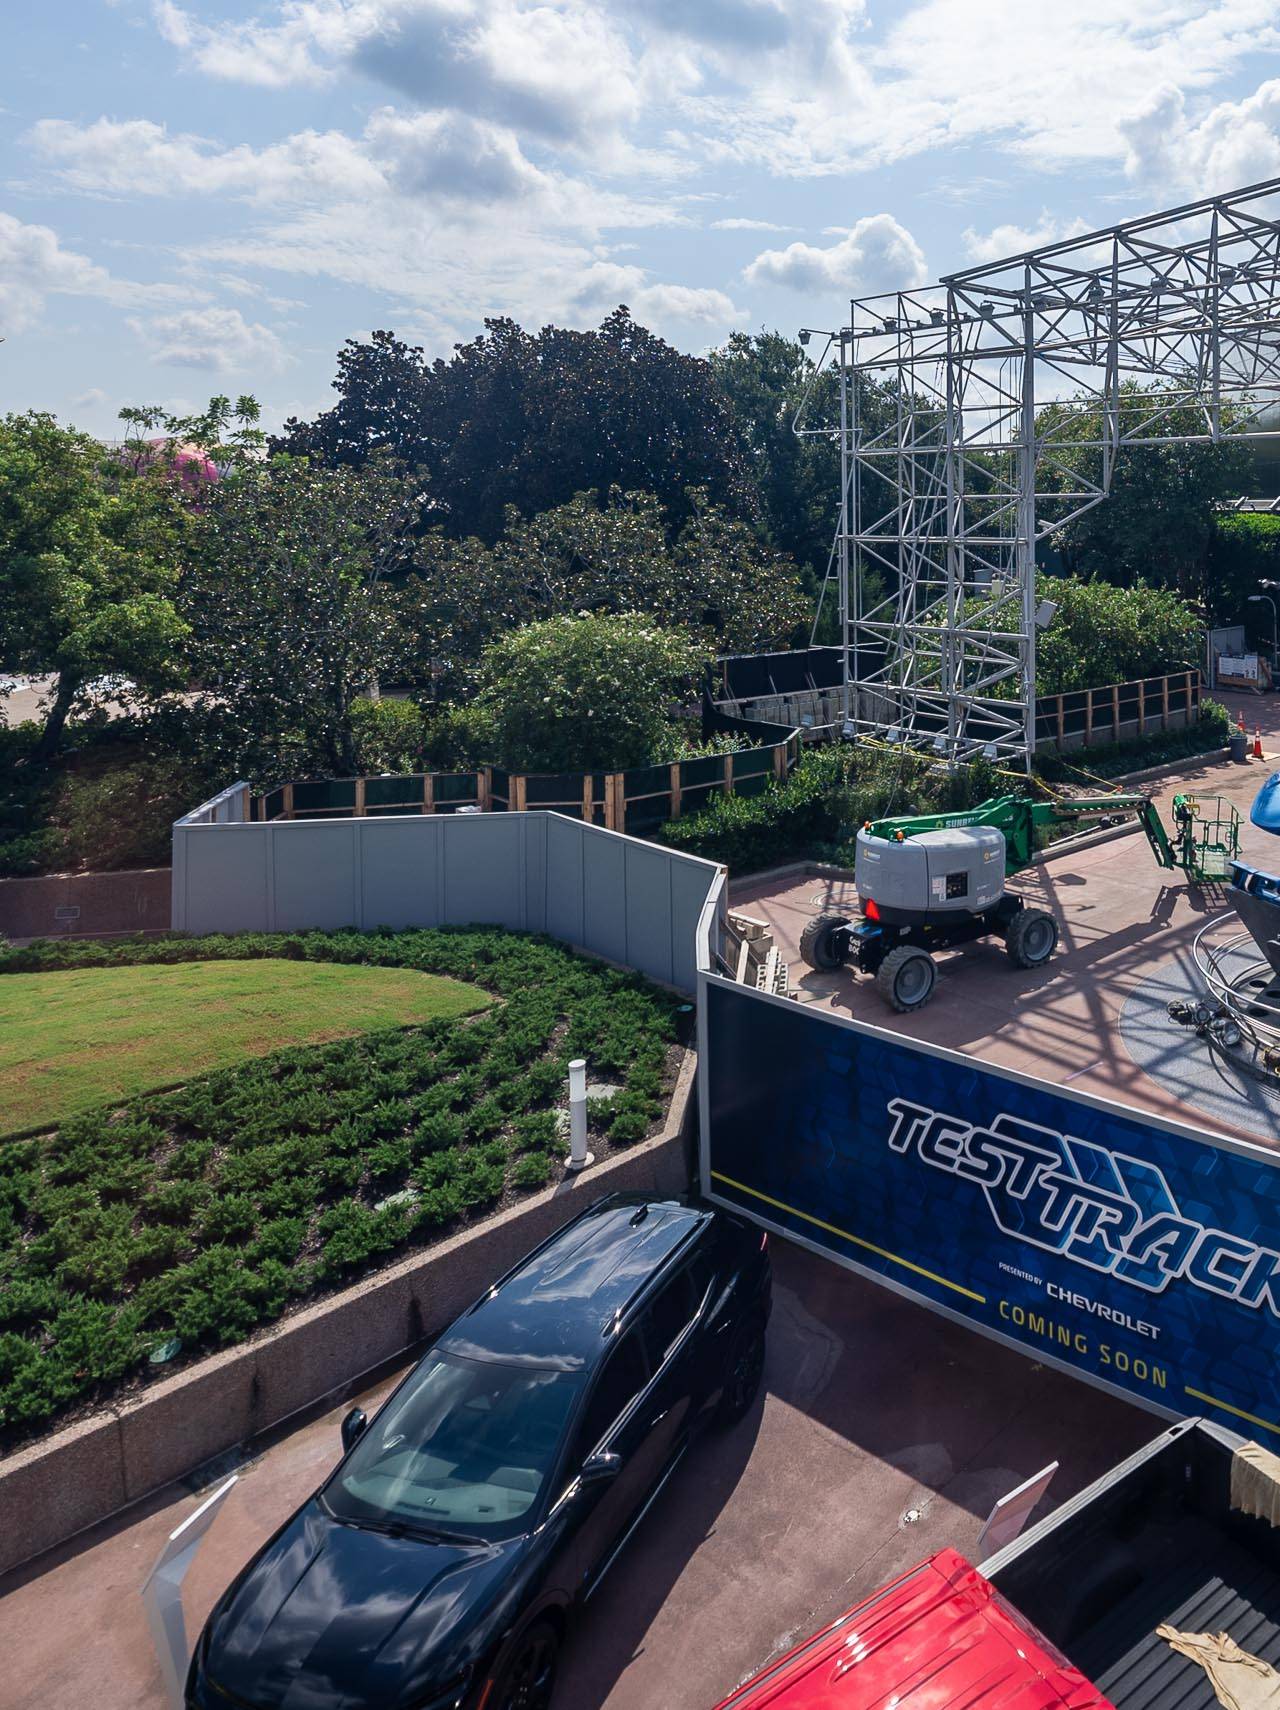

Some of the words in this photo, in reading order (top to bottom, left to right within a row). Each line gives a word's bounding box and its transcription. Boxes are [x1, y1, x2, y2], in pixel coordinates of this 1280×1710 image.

[887, 1097, 1062, 1201] TEST
[998, 1262, 1034, 1282] PRESENTED
[1033, 1276, 1043, 1286] BY
[1046, 1282, 1161, 1340] CHEVROLET
[999, 1300, 1088, 1354] COMING
[1100, 1343, 1167, 1389] SOON
